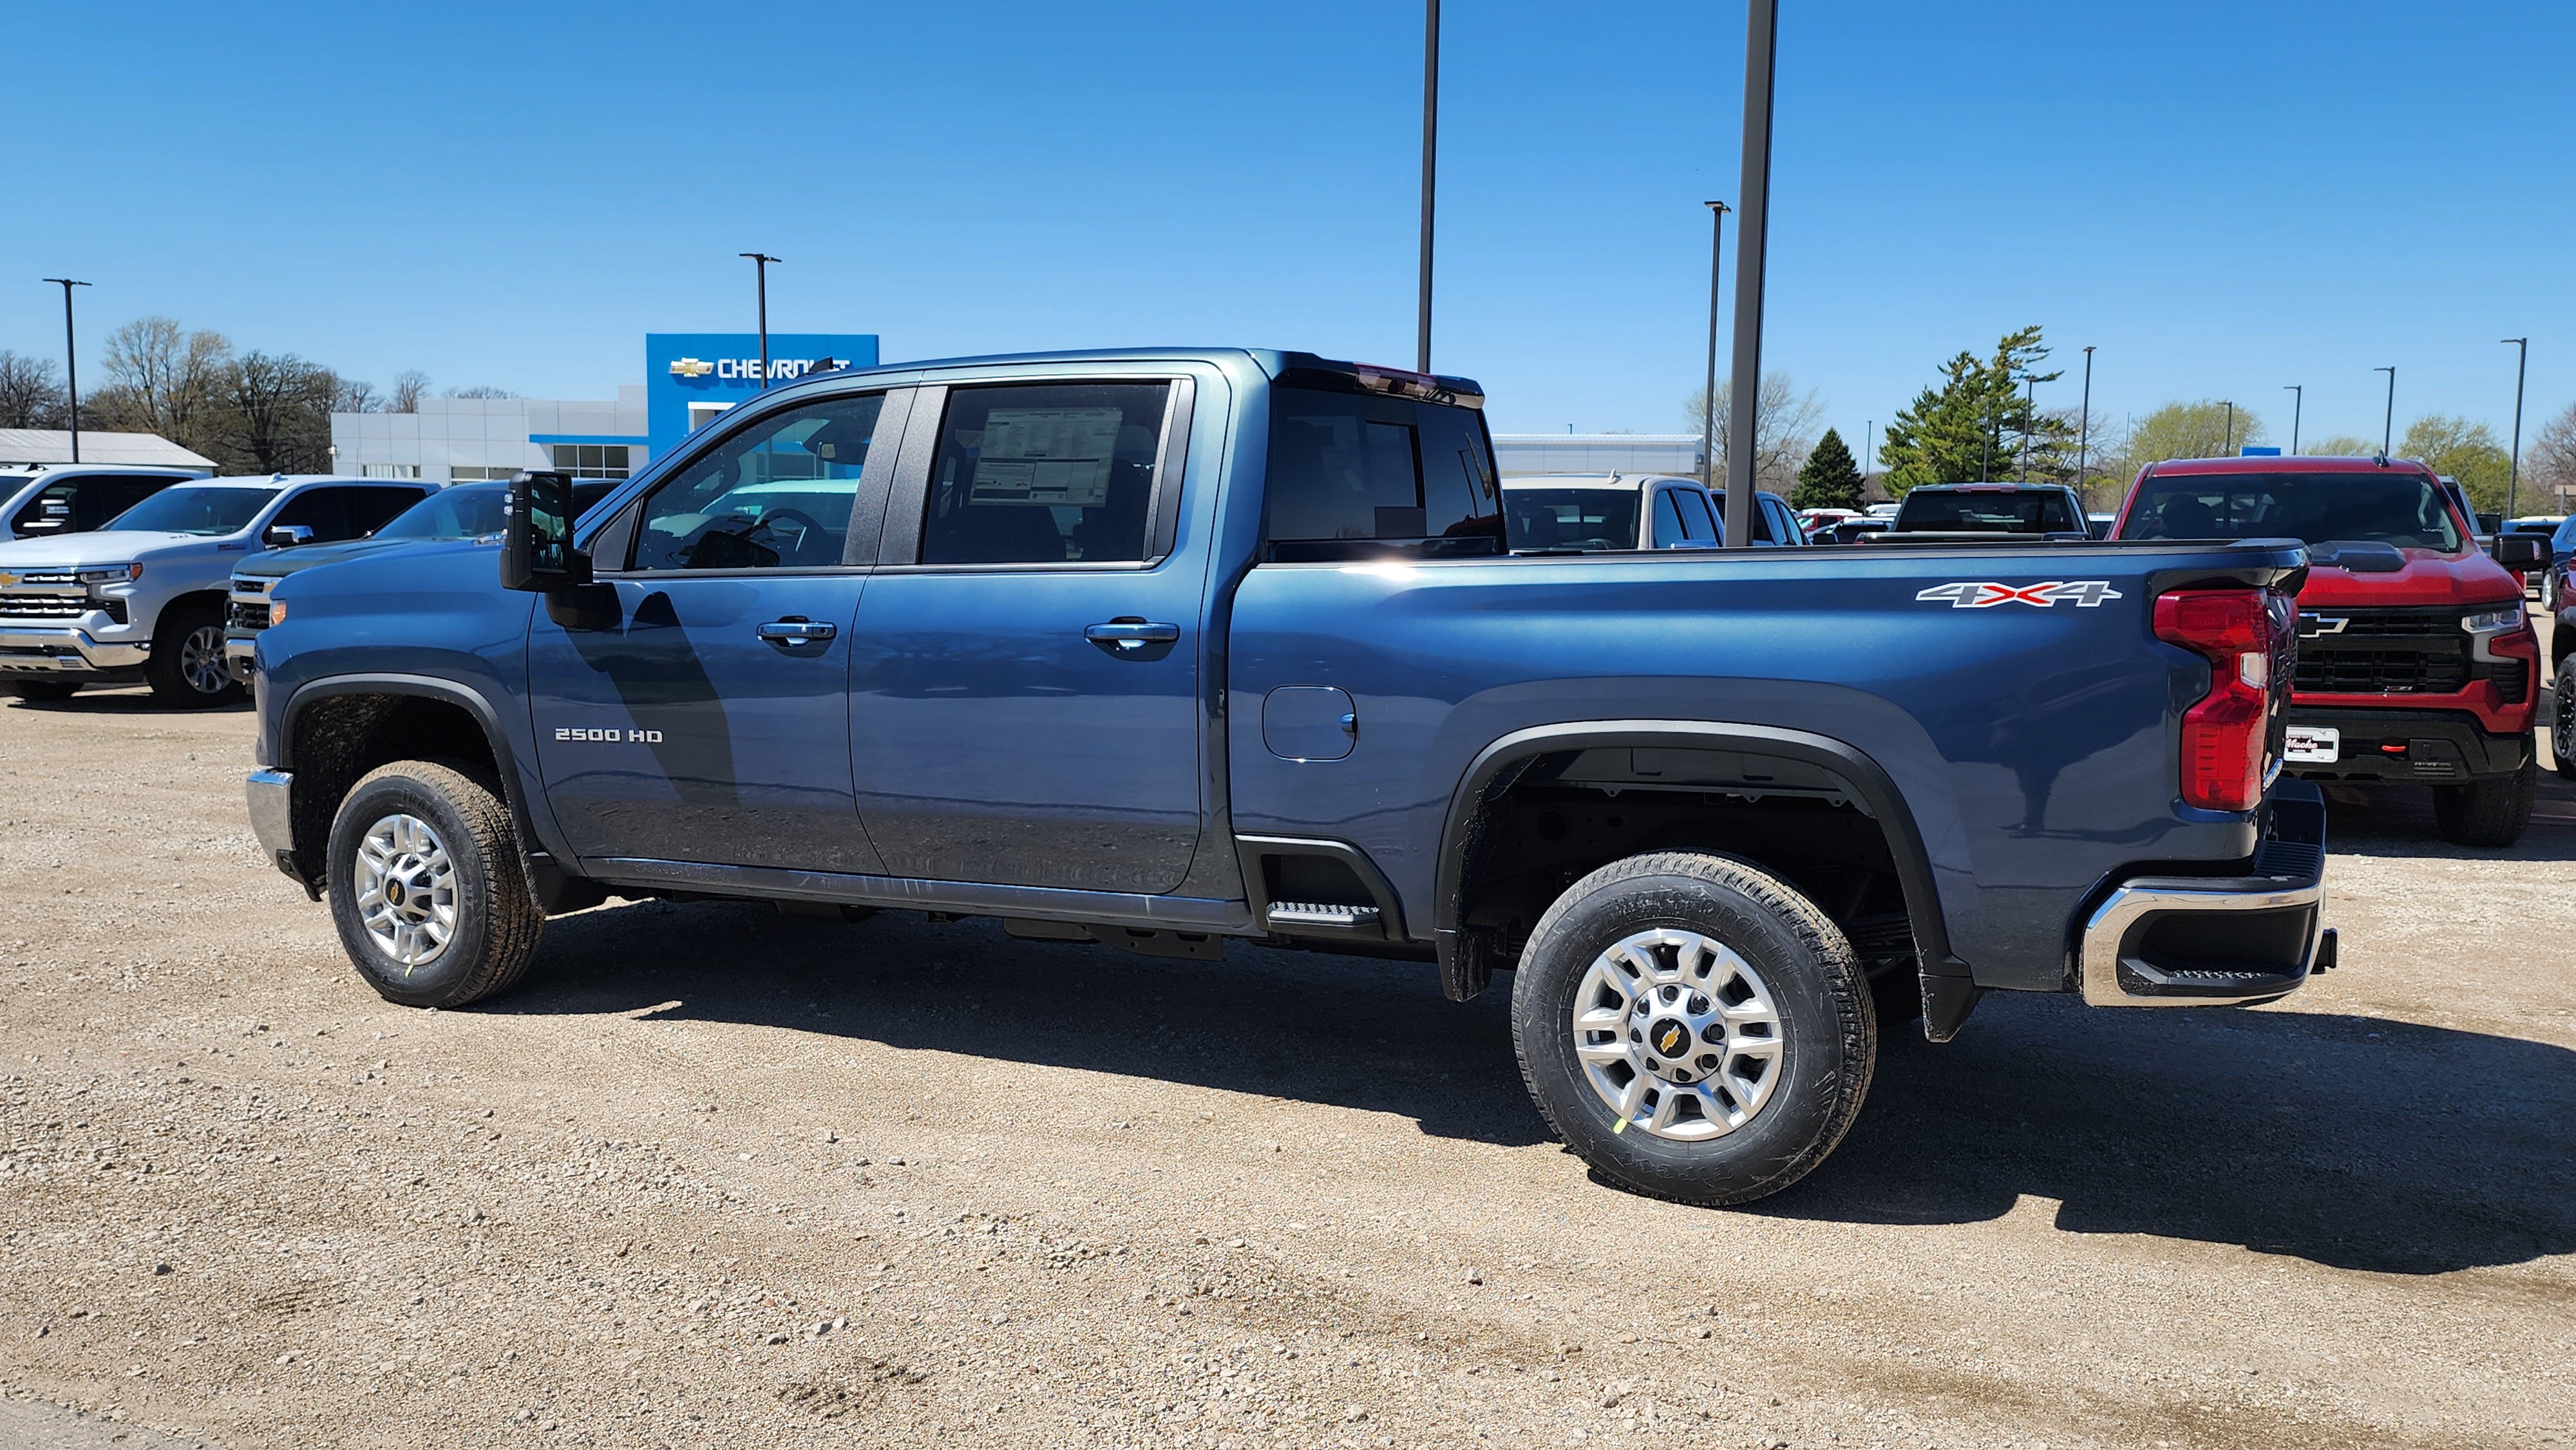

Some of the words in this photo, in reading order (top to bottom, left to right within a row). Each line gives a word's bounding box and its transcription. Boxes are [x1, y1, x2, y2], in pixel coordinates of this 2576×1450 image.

[717, 359, 850, 379] CHEVROT
[555, 727, 621, 742] 2500
[629, 729, 663, 743] HD
